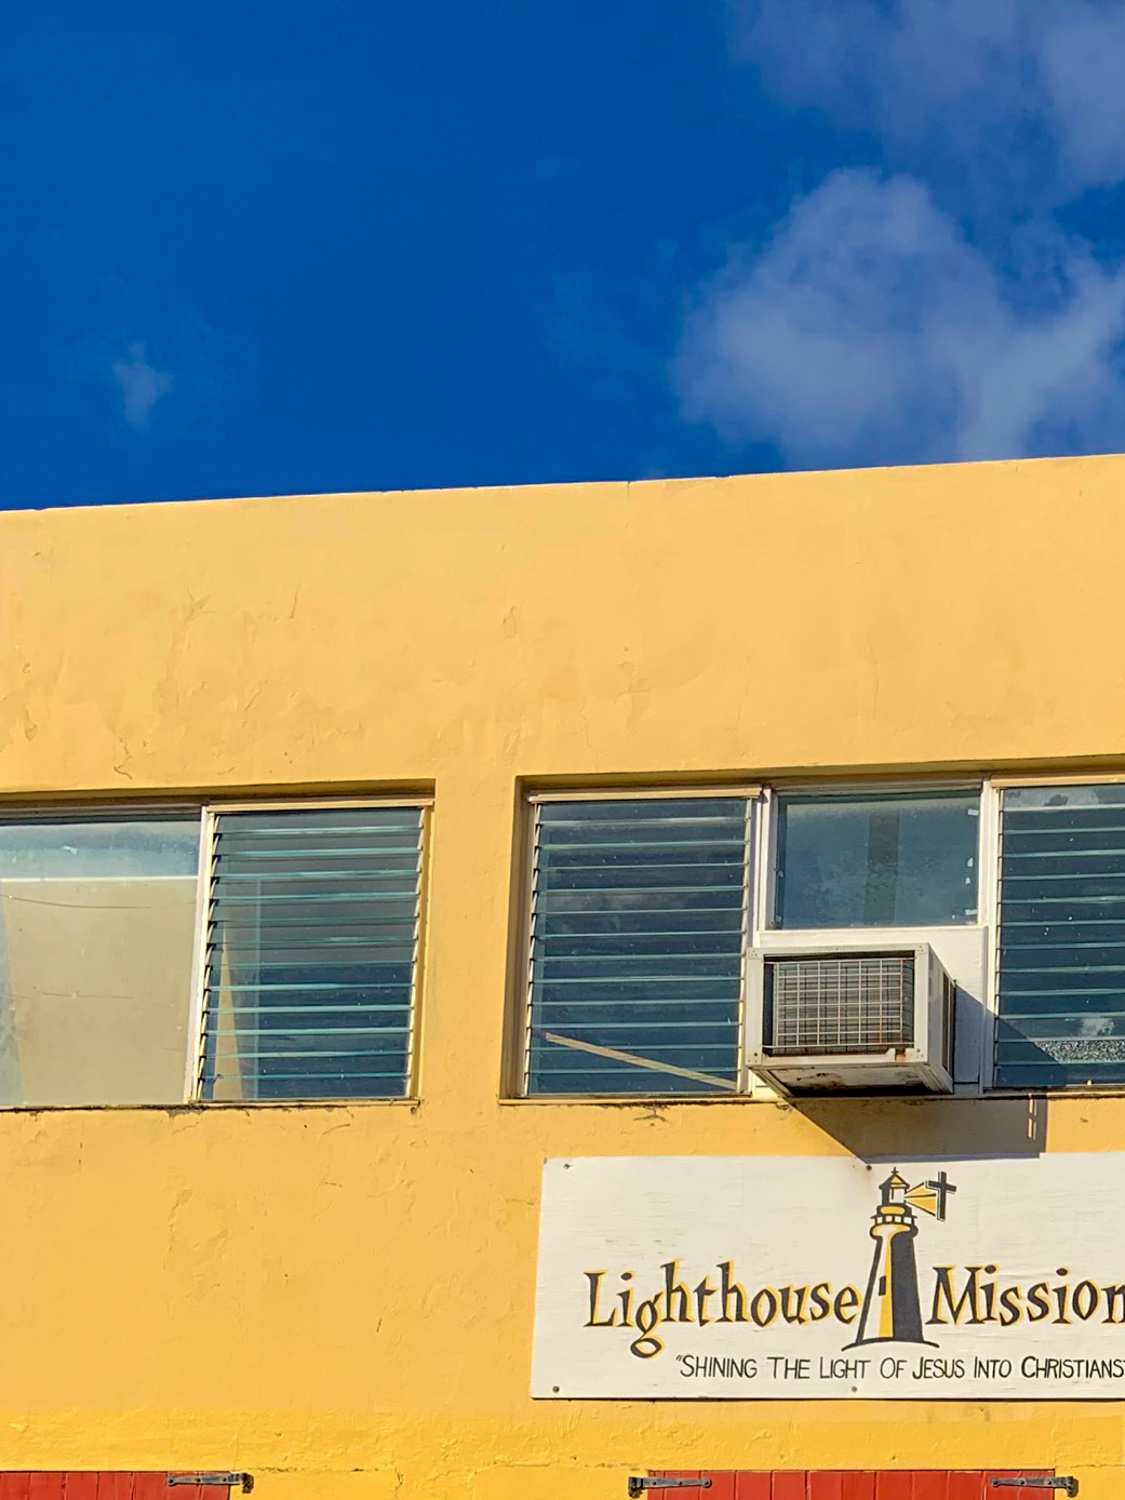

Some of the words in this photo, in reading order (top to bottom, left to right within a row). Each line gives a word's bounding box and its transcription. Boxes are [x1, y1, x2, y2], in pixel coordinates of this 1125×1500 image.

[583, 1258, 862, 1359] Lighthouse
[767, 1356, 811, 1380] THE
[819, 1356, 871, 1379] LIGHT
[880, 1357, 907, 1379] OF
[912, 1356, 965, 1380] JESUS
[974, 1356, 1012, 1379] INTO
